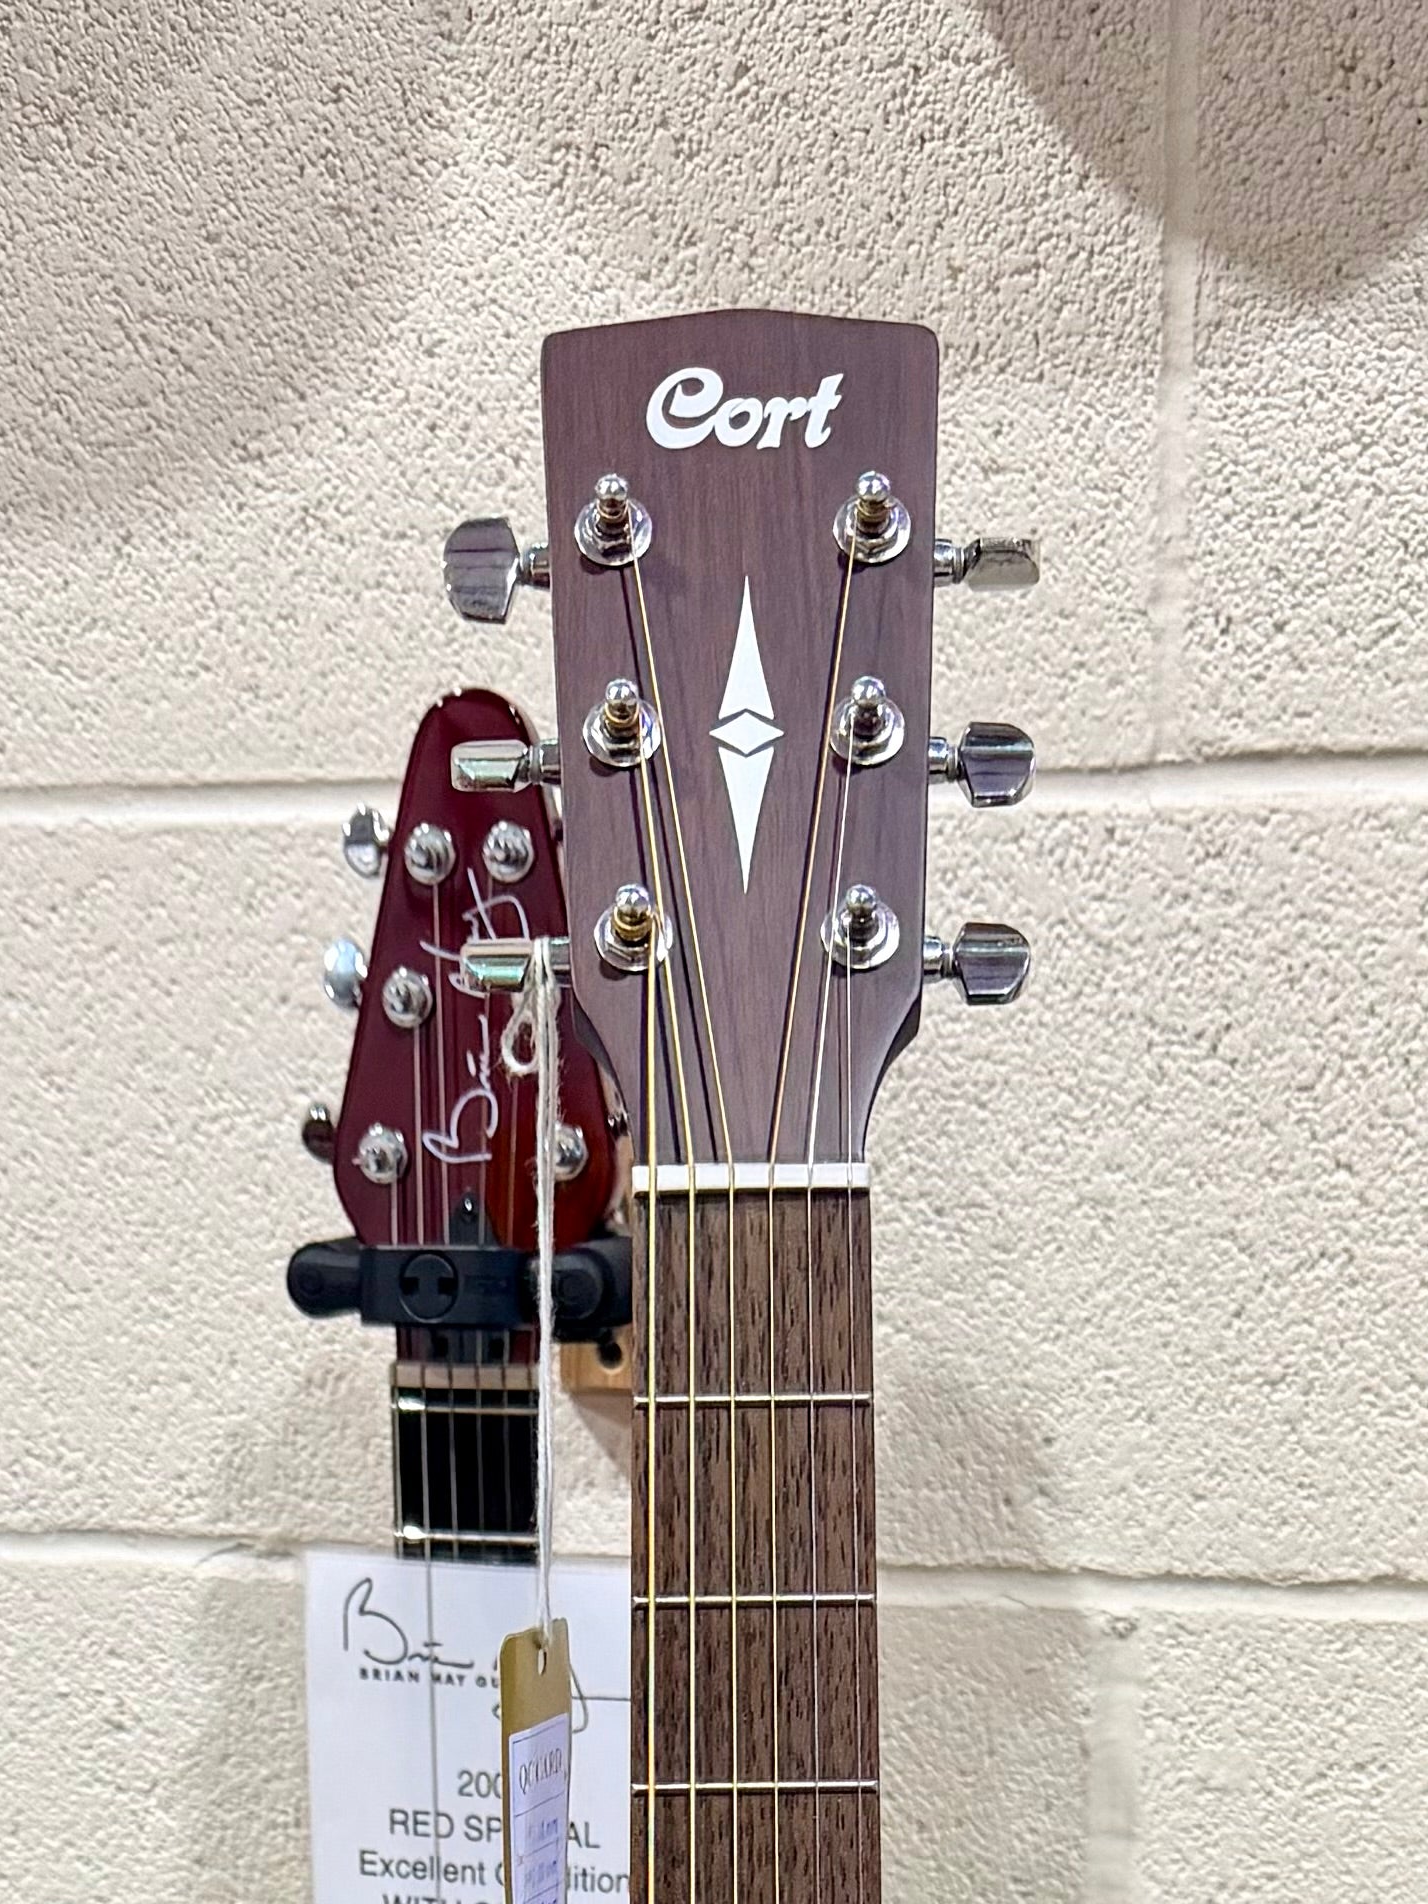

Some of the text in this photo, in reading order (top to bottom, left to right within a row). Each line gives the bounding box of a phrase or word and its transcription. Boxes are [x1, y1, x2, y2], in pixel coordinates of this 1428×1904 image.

[645, 366, 845, 450] Cort
[358, 1667, 421, 1684] BRIAN
[430, 1671, 465, 1687] MAY
[388, 1808, 455, 1840] RED
[359, 1849, 487, 1887] Excellent
